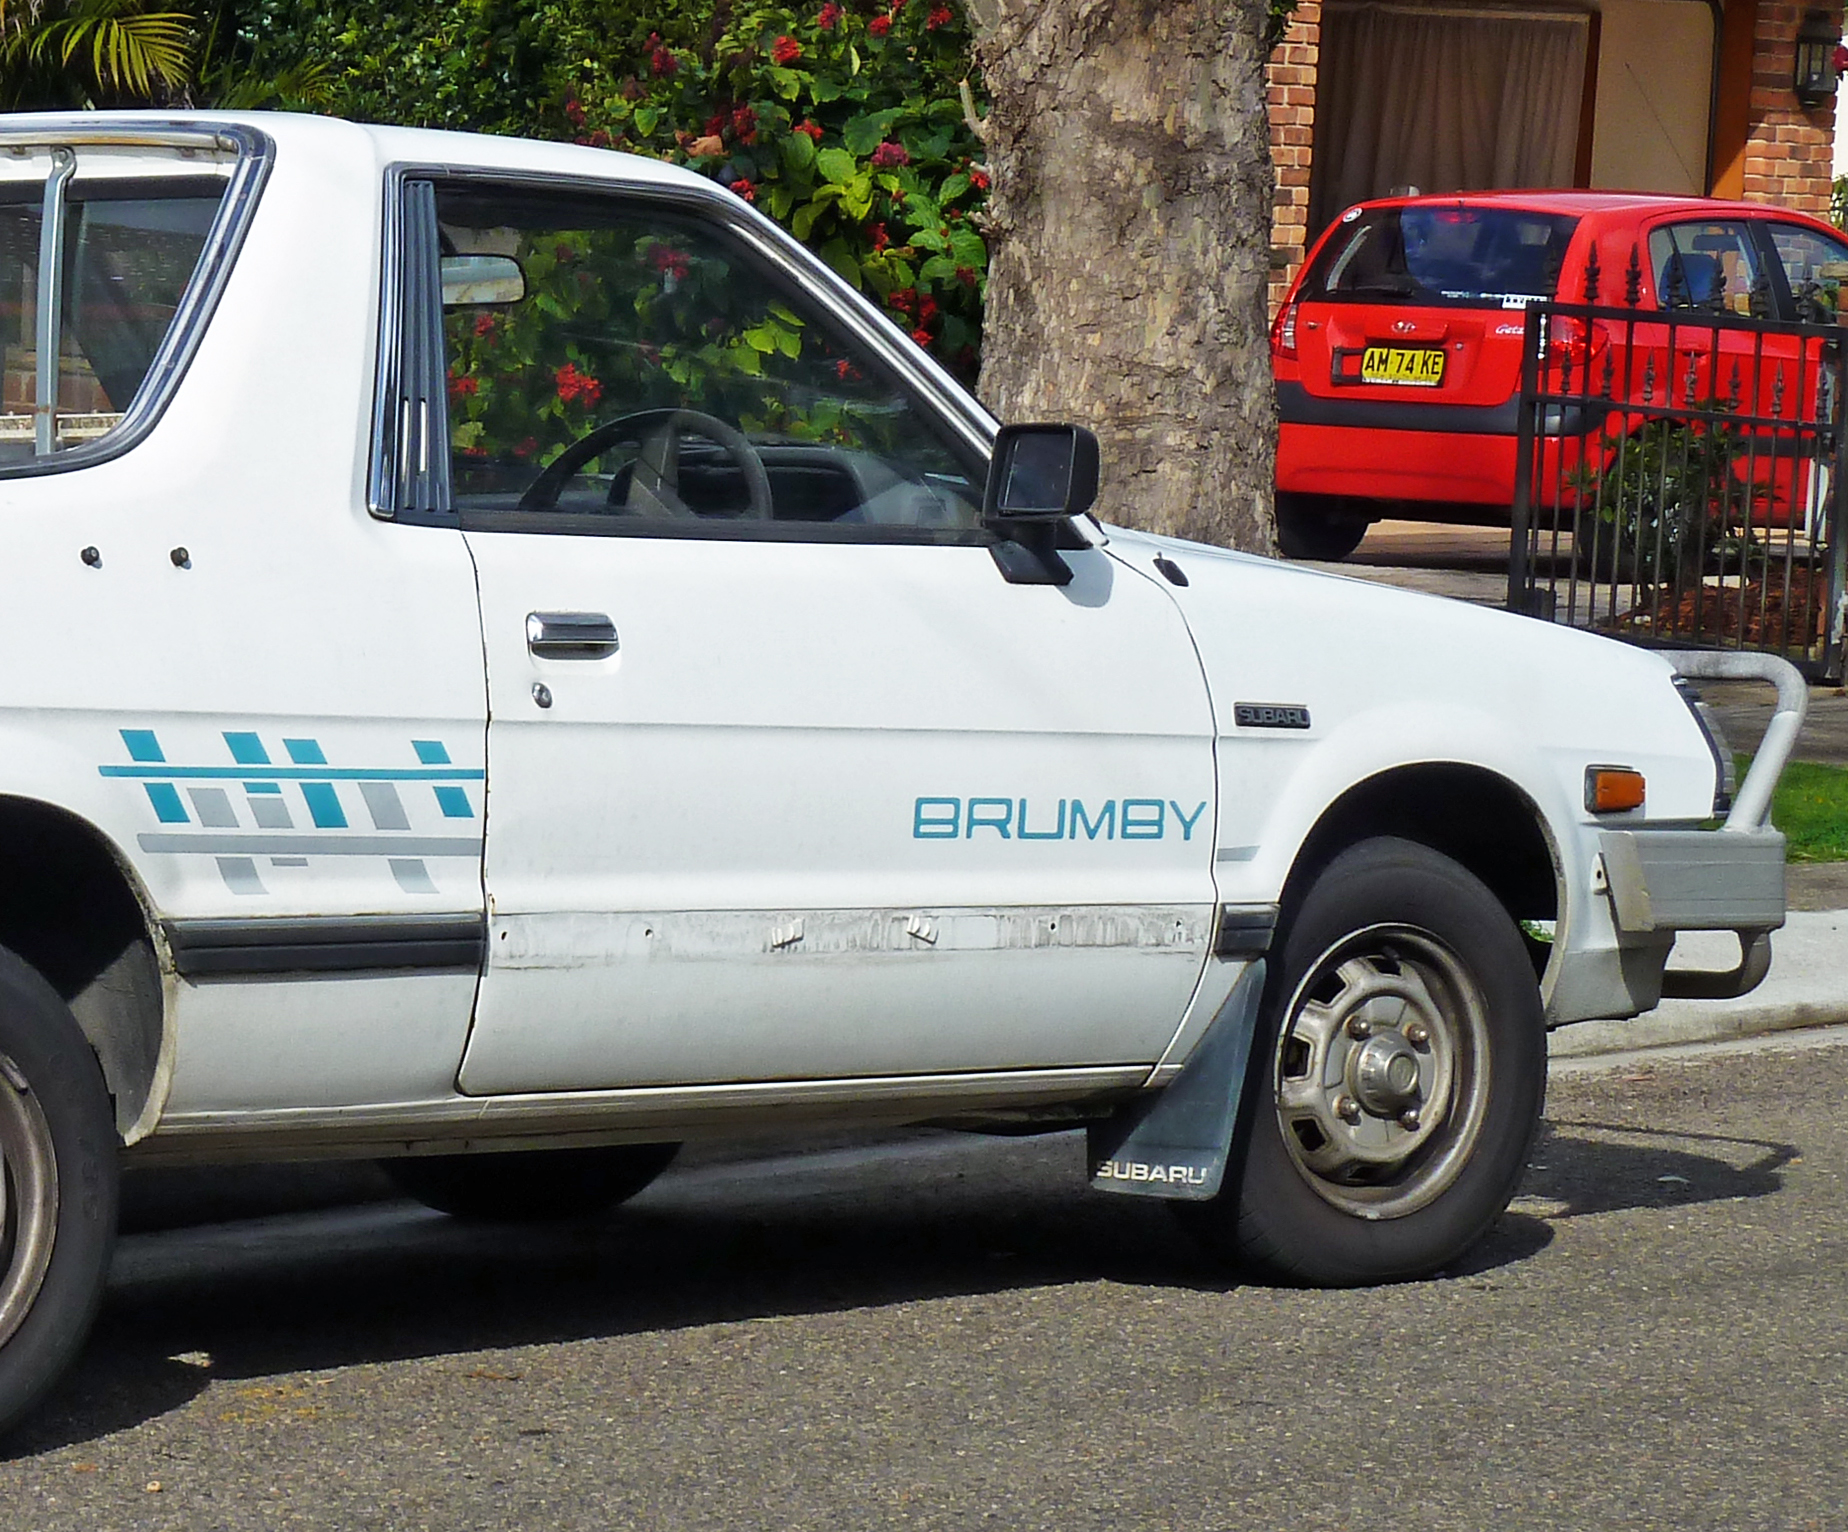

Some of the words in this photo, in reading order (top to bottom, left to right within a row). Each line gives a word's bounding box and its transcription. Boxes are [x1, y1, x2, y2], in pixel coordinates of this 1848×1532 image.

[1364, 351, 1388, 374] AM
[1395, 352, 1415, 376] 74
[1421, 352, 1443, 376] KE
[1238, 707, 1309, 724] SUBARU
[912, 796, 1208, 842] BRUMBY
[1096, 1160, 1208, 1184] SUBARU
